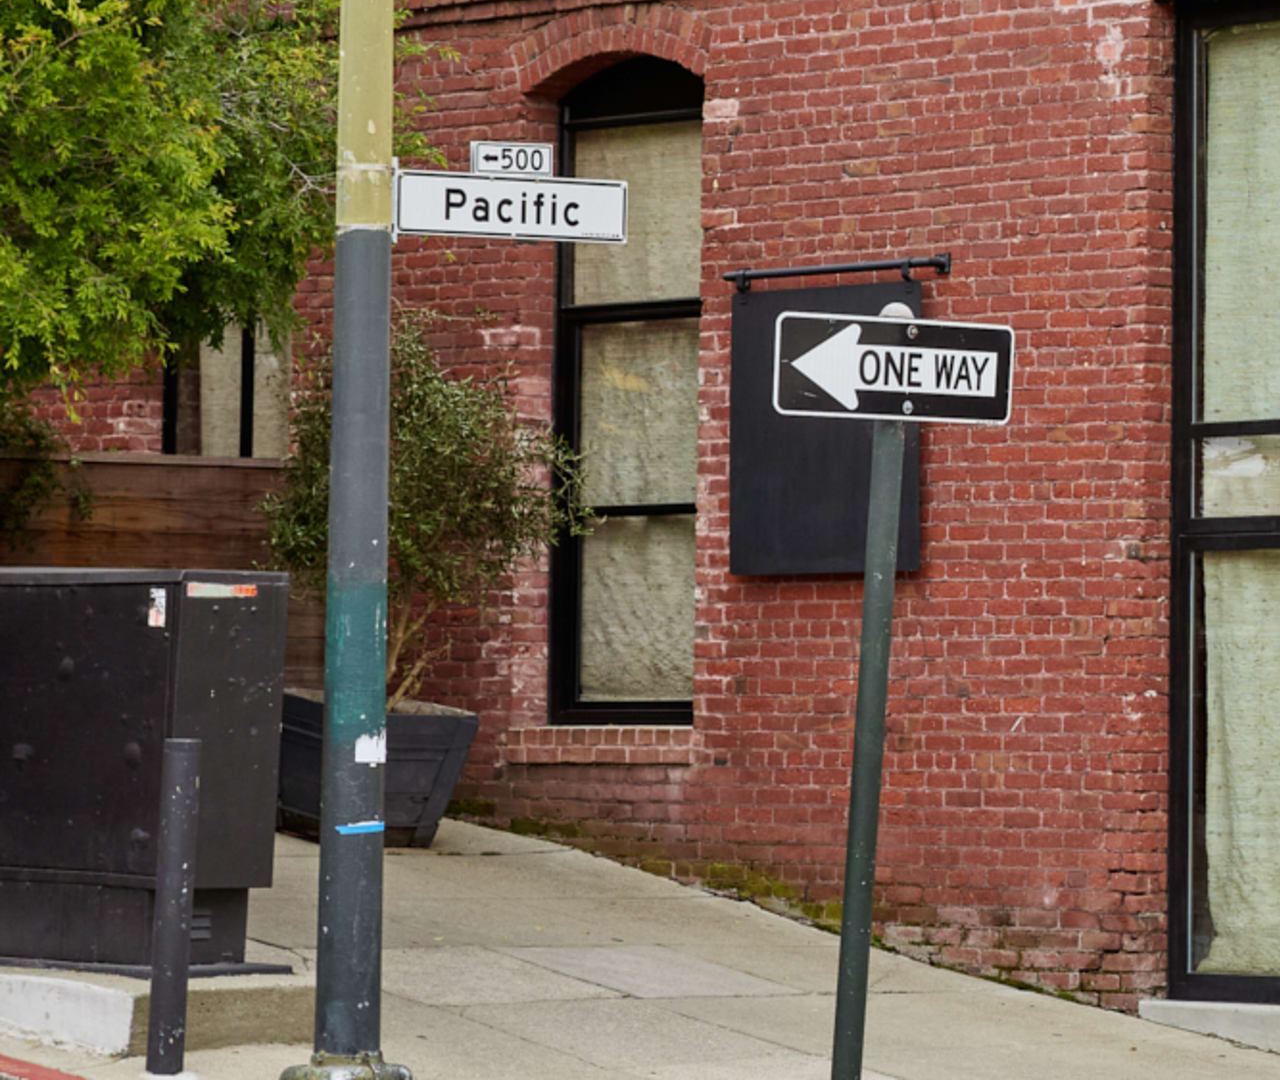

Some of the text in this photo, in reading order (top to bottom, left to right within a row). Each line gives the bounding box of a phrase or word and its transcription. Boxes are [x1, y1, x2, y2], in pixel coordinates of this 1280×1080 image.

[501, 148, 543, 170] 500
[445, 188, 580, 226] Pacific
[860, 350, 989, 391] ONE WAY
